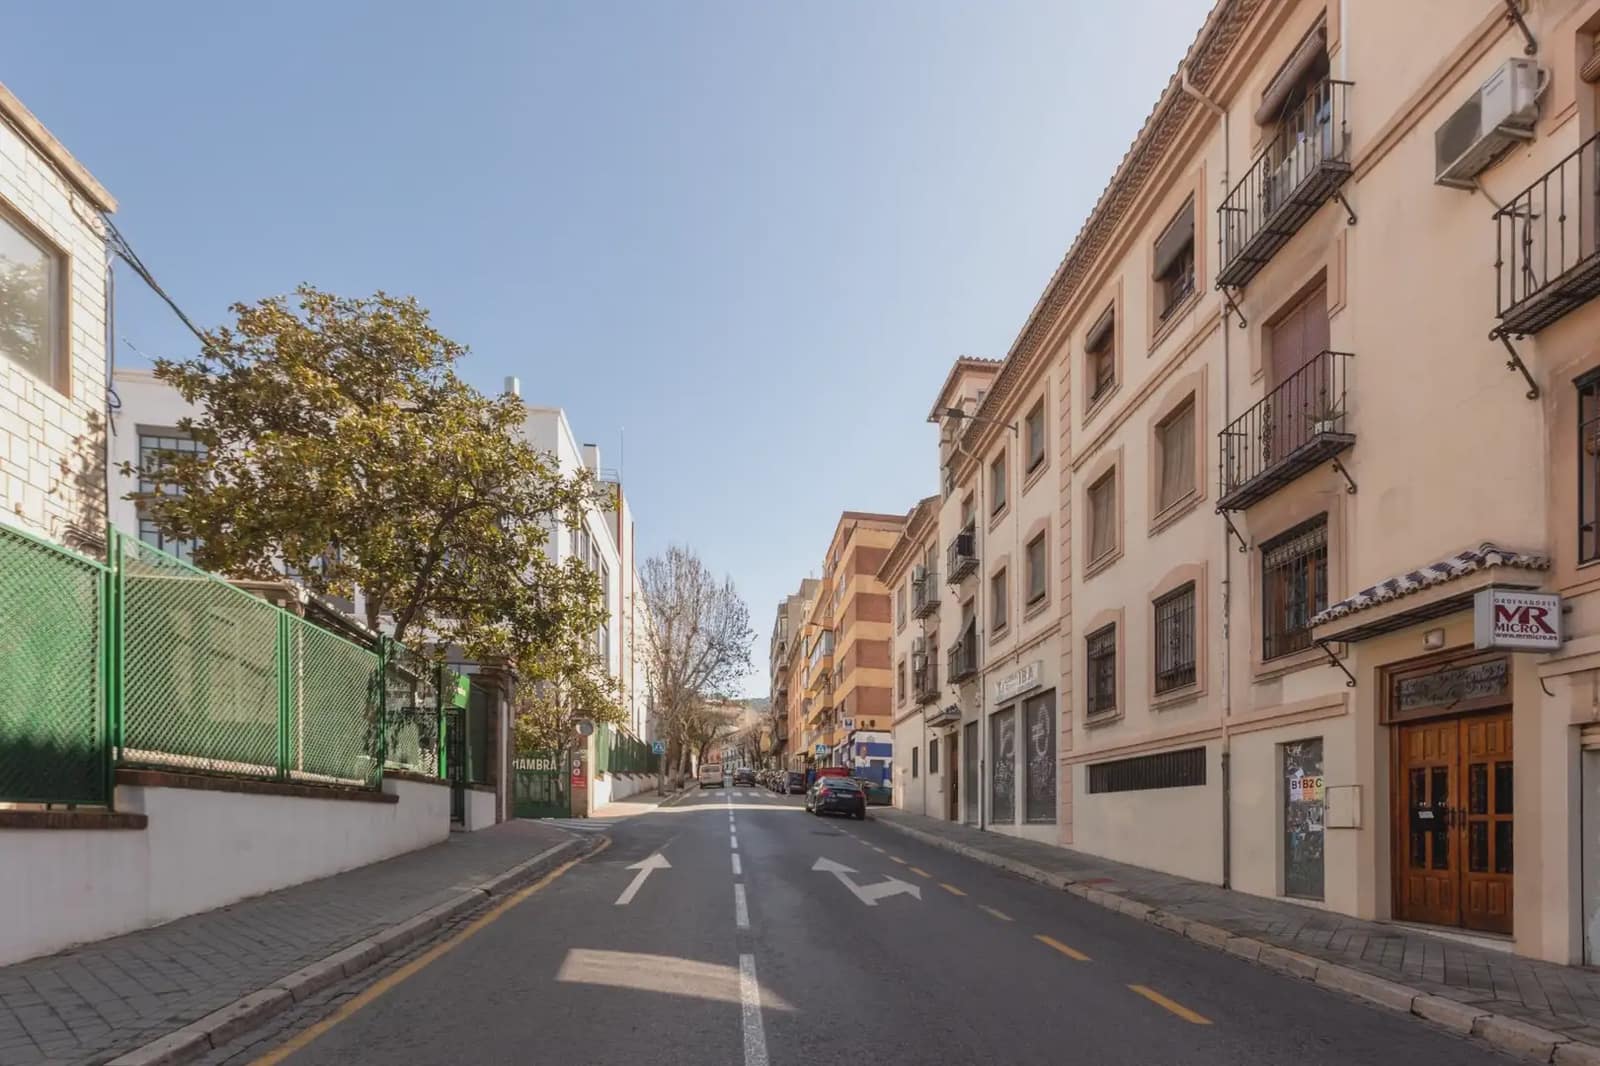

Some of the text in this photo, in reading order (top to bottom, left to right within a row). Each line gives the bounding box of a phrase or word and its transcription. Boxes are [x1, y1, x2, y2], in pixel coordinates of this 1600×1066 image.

[1494, 598, 1557, 607] ORDENADORES
[1494, 604, 1557, 634] MR
[1494, 622, 1541, 634] MICRO
[1303, 778, 1314, 789] B2
